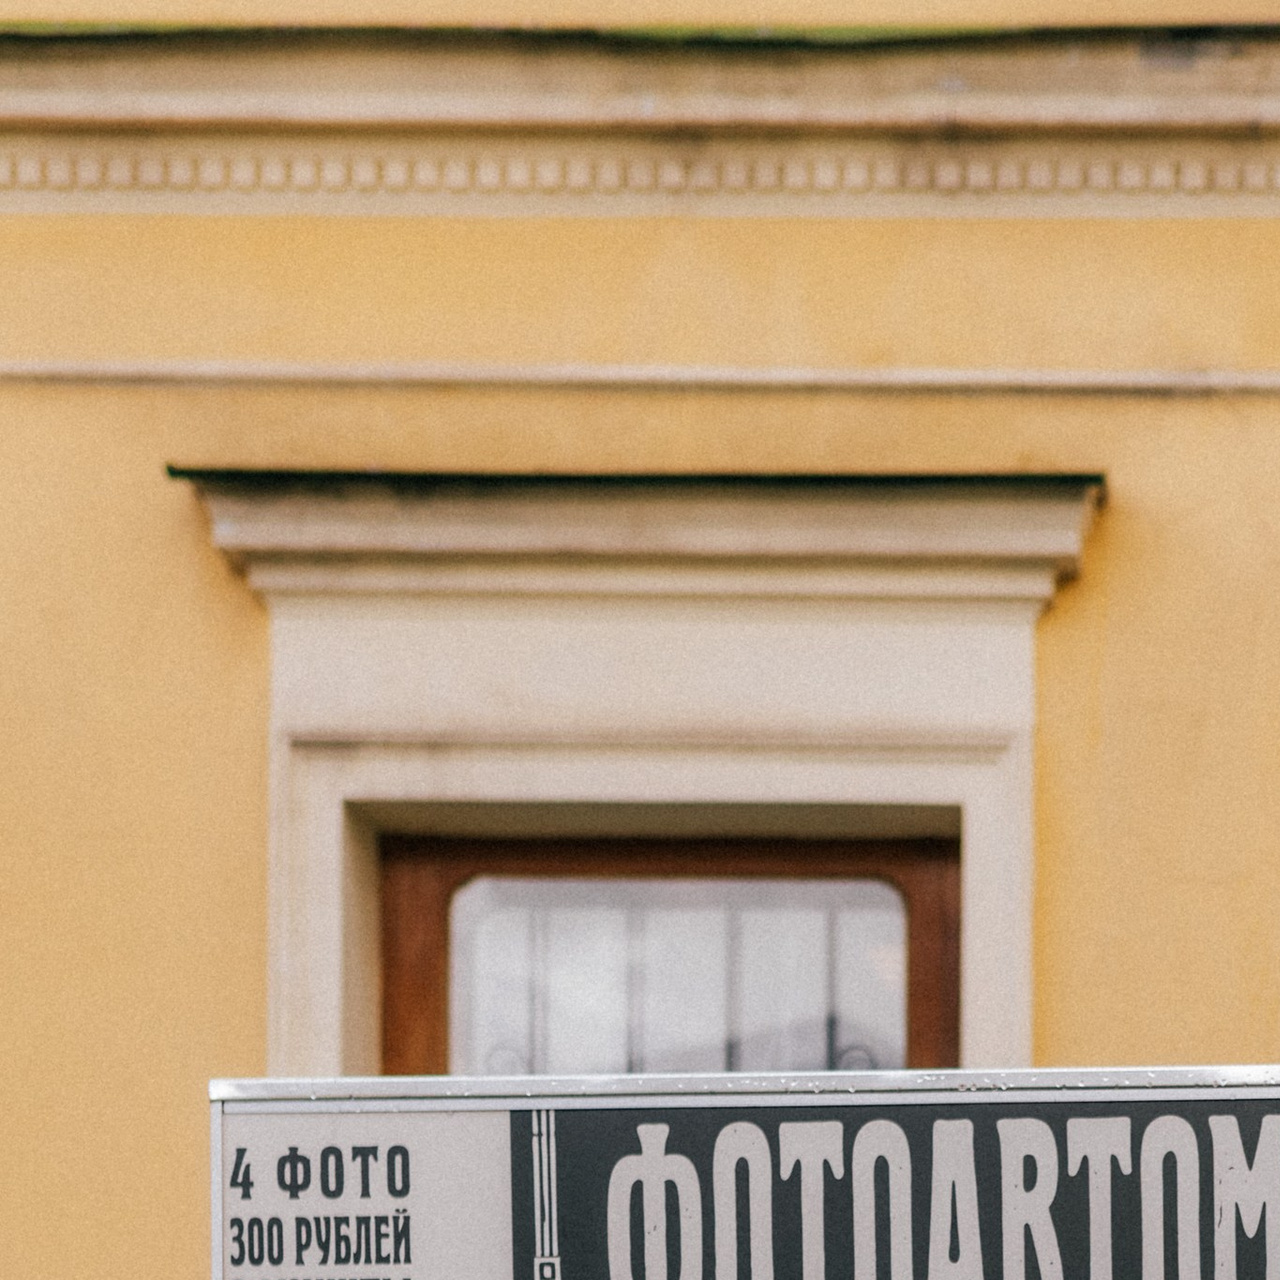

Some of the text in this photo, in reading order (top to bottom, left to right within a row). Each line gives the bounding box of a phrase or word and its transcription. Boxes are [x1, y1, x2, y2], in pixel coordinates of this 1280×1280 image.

[230, 1145, 412, 1200] 4 ФОТО
[230, 1208, 414, 1267] 300 РУБЛЕЙ
